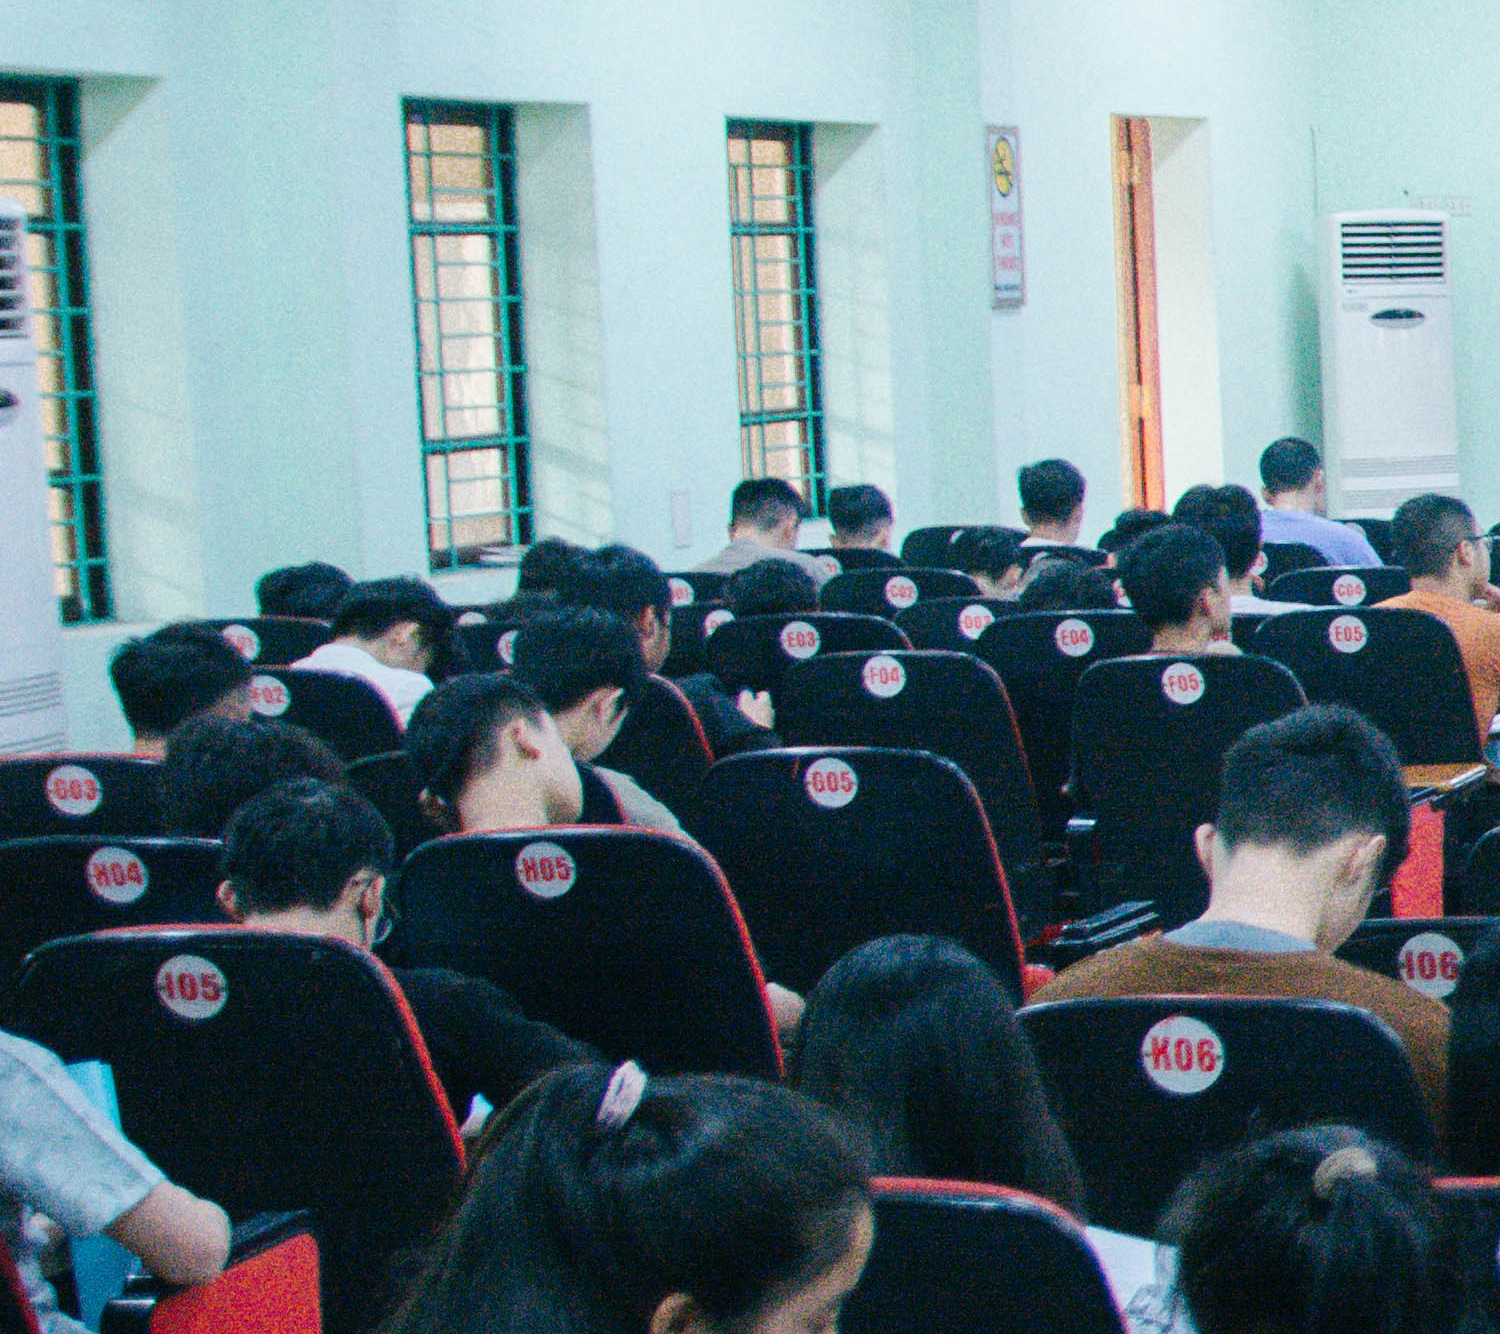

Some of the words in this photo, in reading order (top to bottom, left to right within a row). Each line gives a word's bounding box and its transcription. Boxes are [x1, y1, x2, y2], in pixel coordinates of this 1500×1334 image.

[93, 861, 142, 885] H04
[523, 856, 570, 881] H05
[1151, 1037, 1215, 1073] K06
